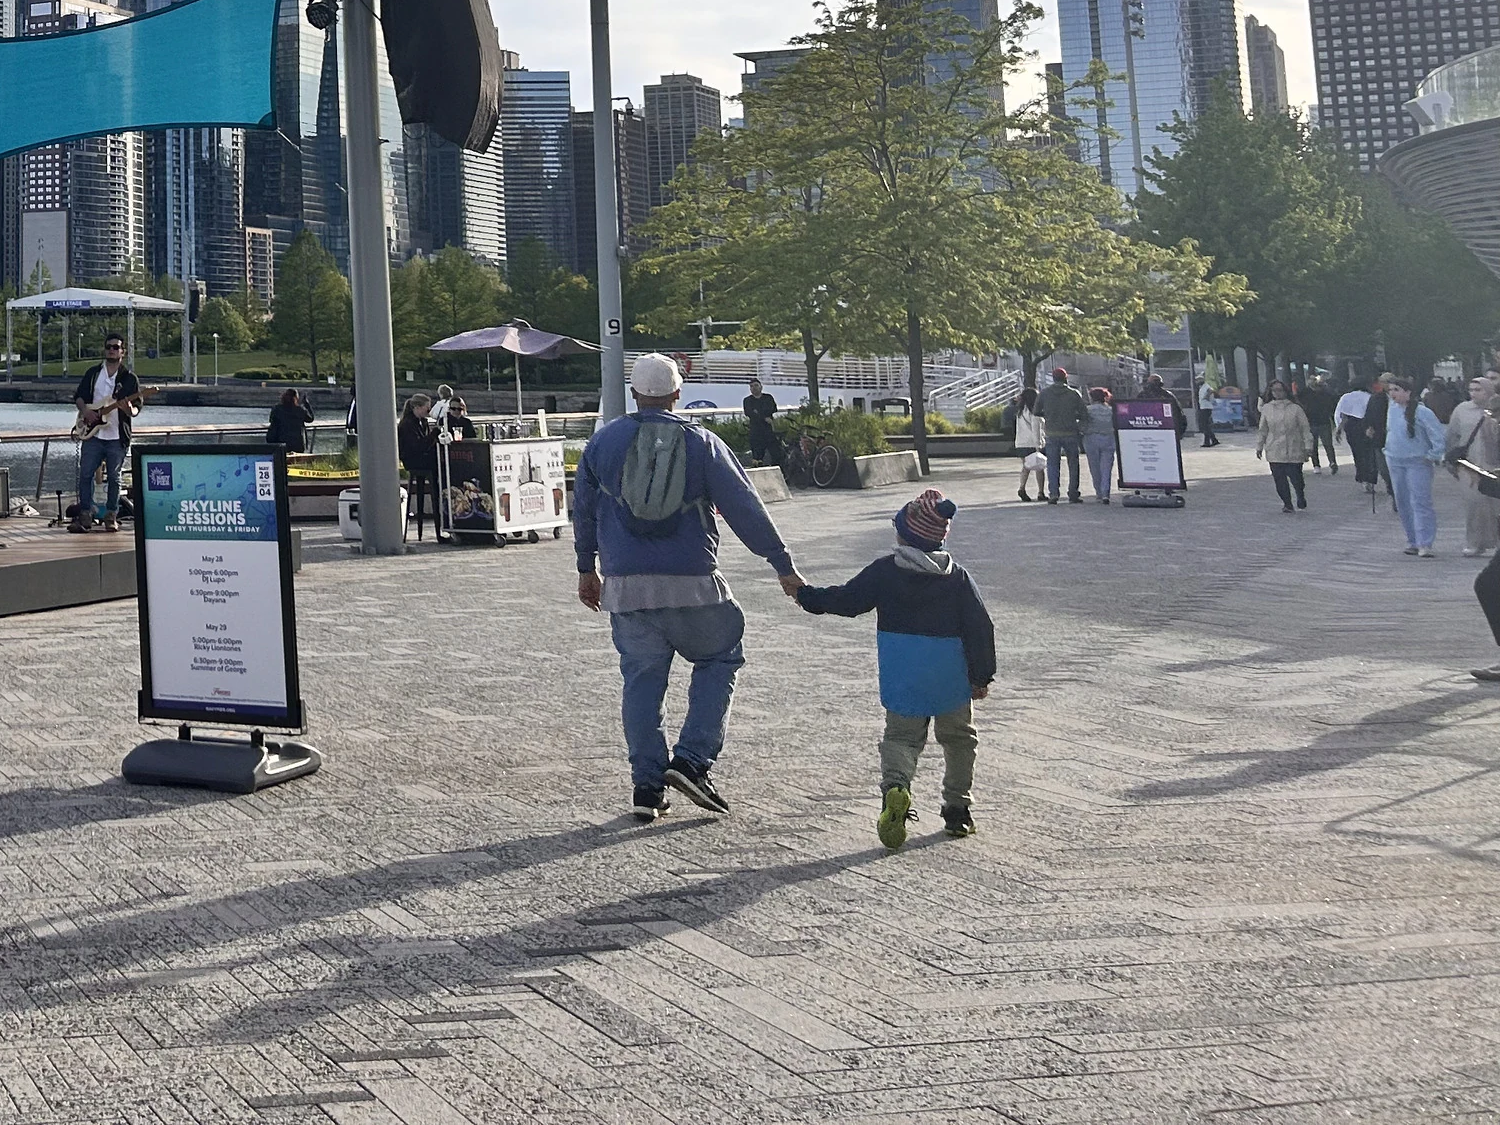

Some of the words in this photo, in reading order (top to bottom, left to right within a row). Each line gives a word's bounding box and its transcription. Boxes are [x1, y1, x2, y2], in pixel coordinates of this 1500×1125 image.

[608, 318, 620, 335] 9
[258, 471, 270, 479] 28
[259, 488, 271, 497] 04
[180, 500, 241, 513] SKYLINE
[177, 512, 246, 526] SESSIONS
[201, 555, 214, 563] May
[188, 569, 239, 577] 5:00pm-6:00pm
[210, 576, 226, 584] Lupo
[190, 589, 239, 598] 6:30pm-9:00pm
[205, 623, 218, 632] May
[219, 623, 227, 631] 29
[192, 637, 243, 646] 5:00pm-6:00pm
[193, 657, 244, 666] 6:30pm-9:00pm
[224, 665, 247, 674] George
